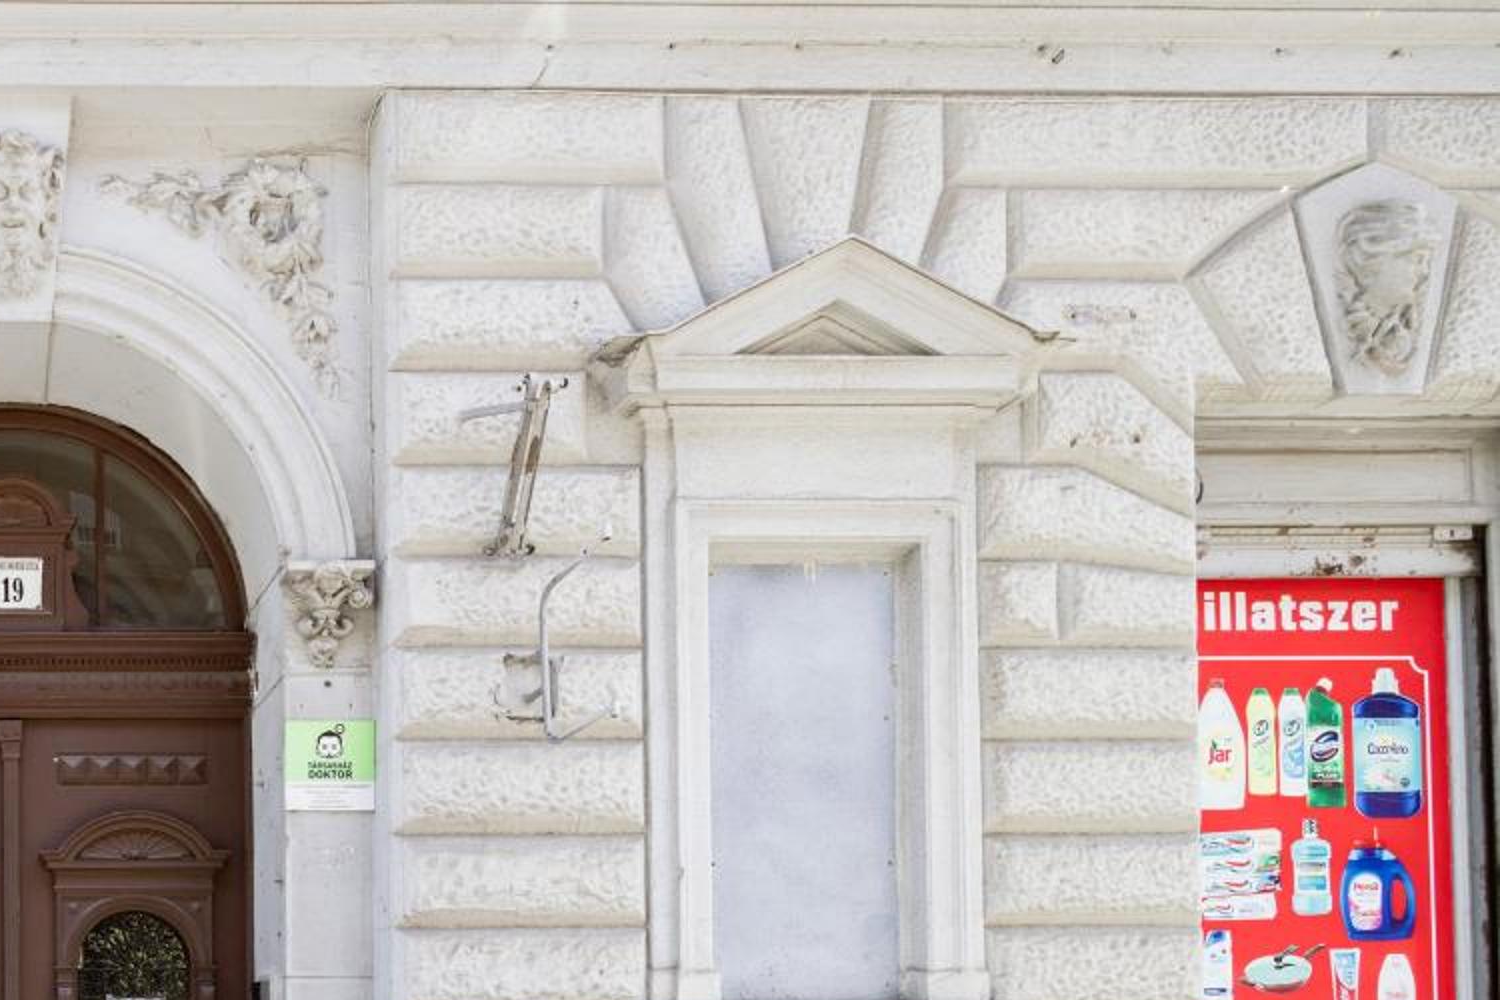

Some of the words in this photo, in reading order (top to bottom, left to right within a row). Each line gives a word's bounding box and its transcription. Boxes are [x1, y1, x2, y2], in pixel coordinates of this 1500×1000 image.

[2, 577, 24, 603] 19
[1203, 591, 1399, 632] illatszer
[307, 769, 353, 780] DOKTOR
